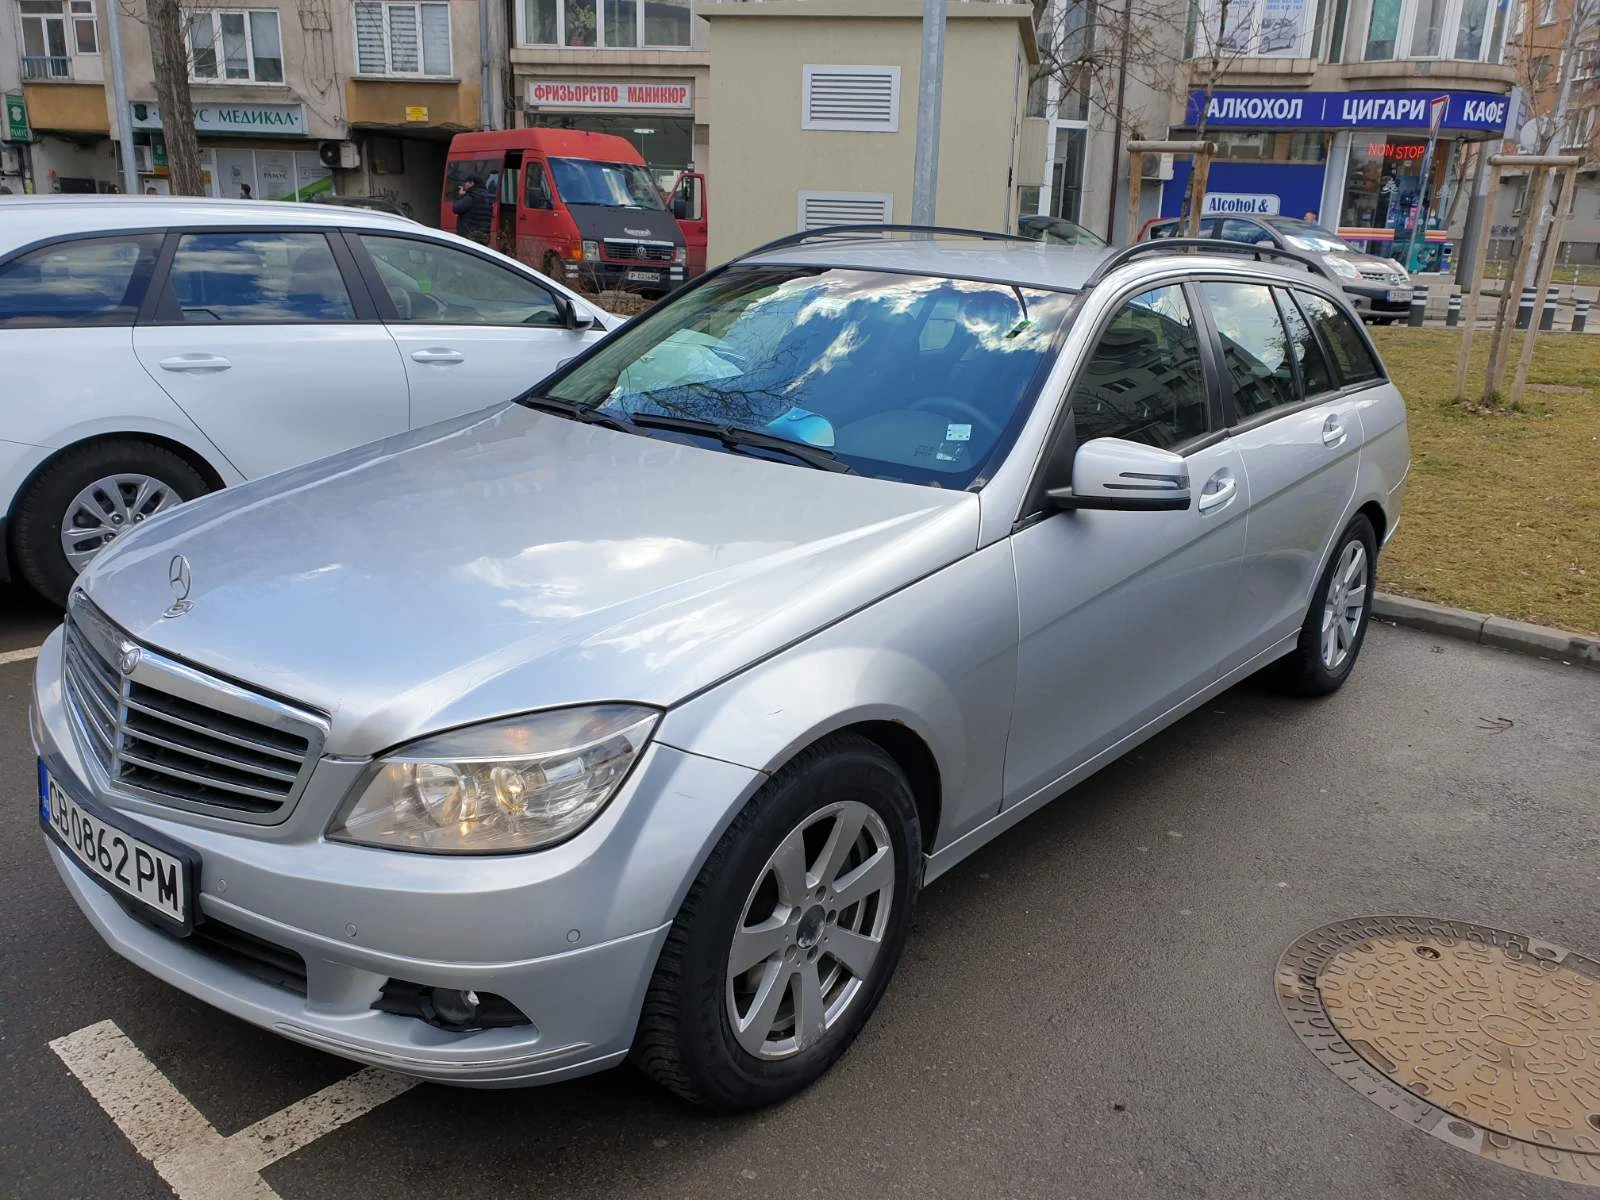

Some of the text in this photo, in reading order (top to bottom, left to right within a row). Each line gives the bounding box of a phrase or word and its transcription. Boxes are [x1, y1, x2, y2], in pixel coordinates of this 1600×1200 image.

[534, 84, 687, 104] ФРИЗЬОРСТВО МАНИКЮР
[1206, 98, 1304, 119] АЛКОХОЛ
[1342, 98, 1426, 124] ЦИГАРИ
[1463, 100, 1505, 123] КАФЕ
[1367, 143, 1425, 160] NON STOP
[1208, 197, 1269, 213] Alcohol &
